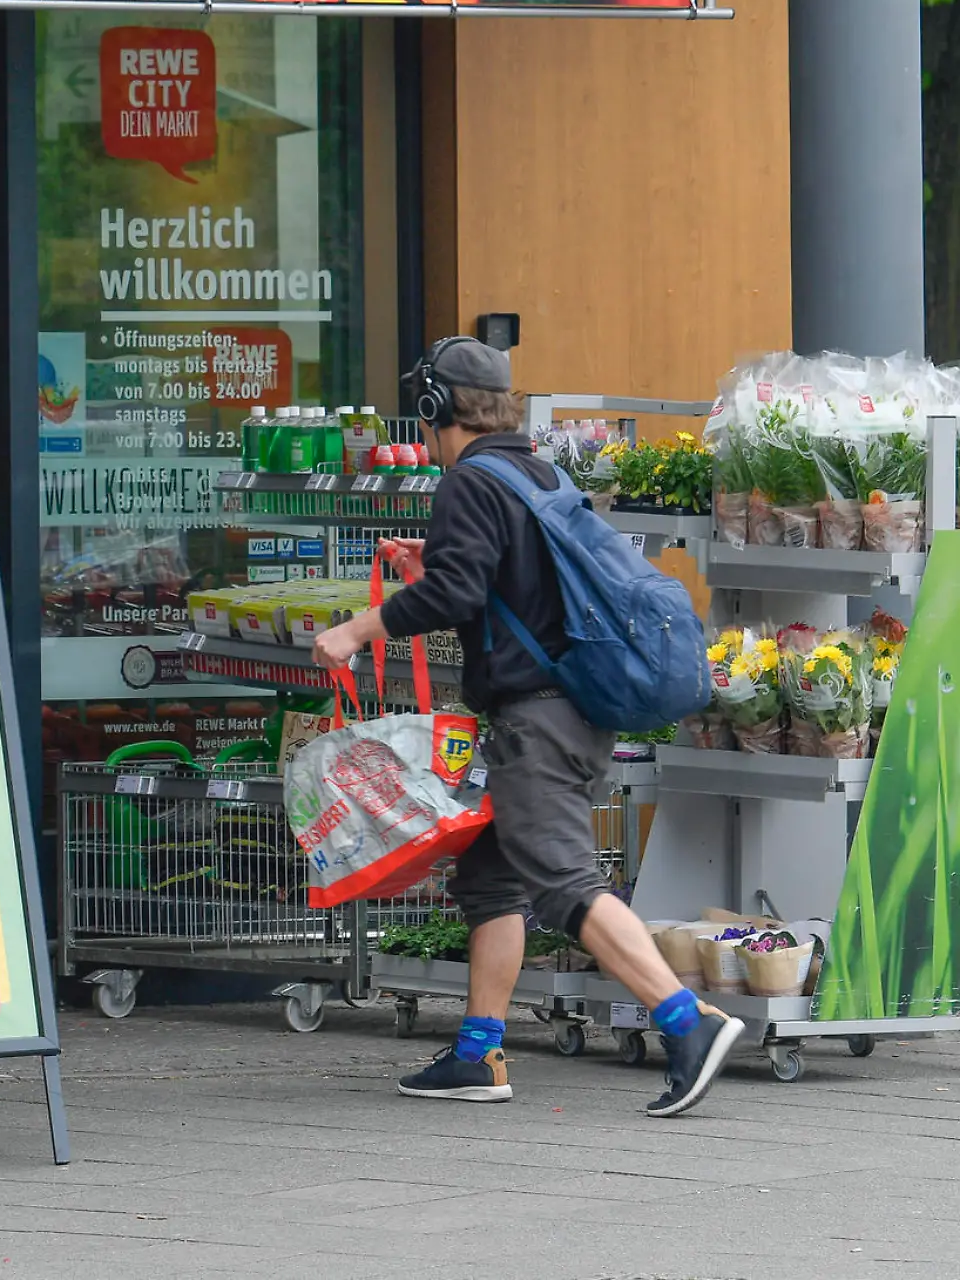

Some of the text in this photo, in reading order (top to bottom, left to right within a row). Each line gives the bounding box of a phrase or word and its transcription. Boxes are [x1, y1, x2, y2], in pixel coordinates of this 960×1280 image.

[120, 49, 199, 75] REWE
[128, 80, 191, 108] CITY
[120, 111, 200, 138] DEIN MARKT
[100, 206, 255, 249] Herzlich
[100, 257, 333, 300] willkommen
[114, 326, 238, 351] Öffnungszeiten:
[115, 357, 273, 377] montags bis freitags
[115, 382, 262, 400] von 7.00 bis 24.00
[115, 407, 187, 426] samstags
[115, 431, 242, 449] von 7.00 bis 23.
[251, 542, 273, 552] VISA
[102, 605, 157, 622] Unsere
[161, 604, 188, 621] Par
[103, 719, 176, 733] www.rewe.de
[195, 718, 226, 732] REWE
[228, 717, 259, 731] Markt
